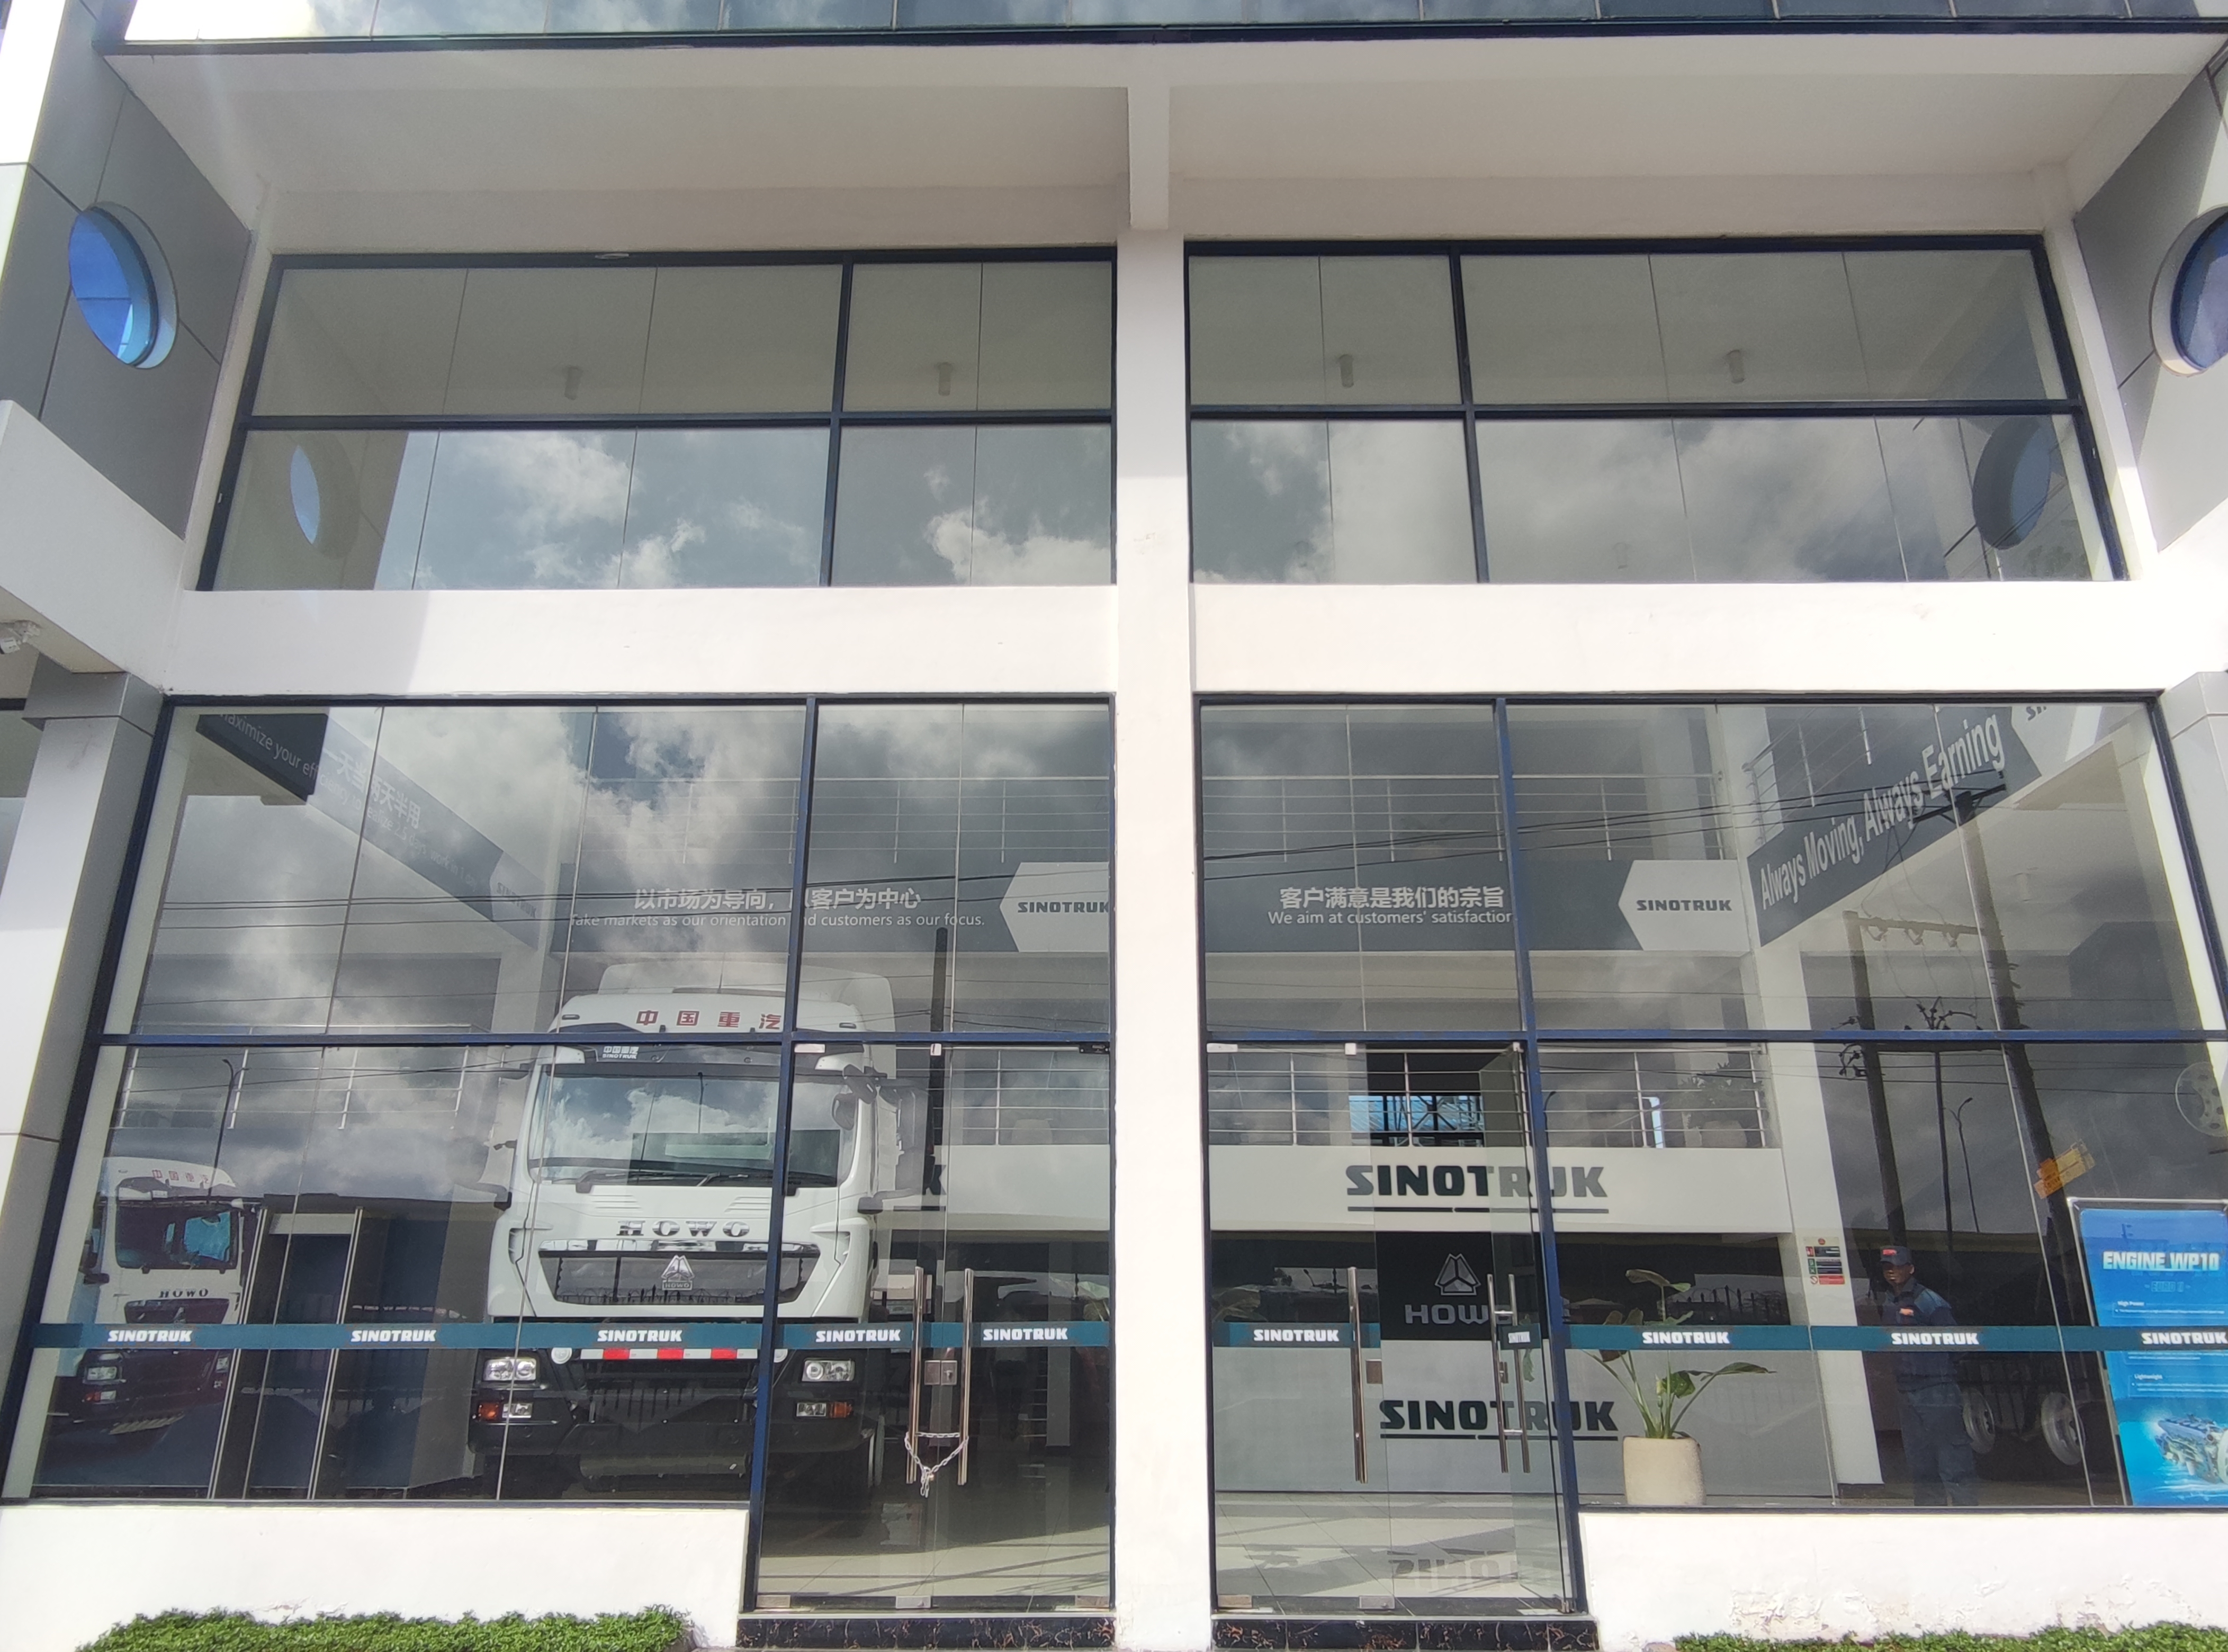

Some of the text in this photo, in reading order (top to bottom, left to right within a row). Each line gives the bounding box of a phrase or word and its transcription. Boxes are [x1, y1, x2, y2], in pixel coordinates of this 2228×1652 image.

[273, 743, 302, 768] your
[1759, 713, 2005, 910] Always Moving, Always Earning
[1279, 886, 1505, 909] 客户满意是我们的宗旨
[1018, 902, 1109, 913] SINOTRUK
[1636, 900, 1733, 911] SINOTRUK
[604, 914, 658, 926] markets
[663, 917, 677, 926] as
[681, 917, 706, 926] our
[710, 913, 786, 926] orientation
[821, 914, 893, 926] customers
[897, 916, 912, 926] as
[916, 915, 940, 926] our
[944, 912, 985, 926] focus.
[1268, 912, 1292, 924] We
[1297, 911, 1324, 923] aim
[1328, 912, 1343, 923] at
[636, 1010, 781, 1030] 中国重汽
[616, 1220, 750, 1237] HOWO
[2103, 1251, 2220, 1271] ENGINE WP10
[158, 1288, 209, 1298] HOWO
[107, 1330, 193, 1342] SINOTRUK
[351, 1330, 437, 1342] SINOTRUK
[597, 1330, 682, 1342] SINOTRUK
[815, 1330, 901, 1342] SINOTRUK
[983, 1328, 1068, 1341] SINOTRUK
[1253, 1329, 1340, 1342] SINOTRUK
[1642, 1331, 1730, 1344] SINOTRUK
[1891, 1332, 1979, 1345] SINOTRUK
[2141, 1332, 2228, 1345] SINOTRUK
